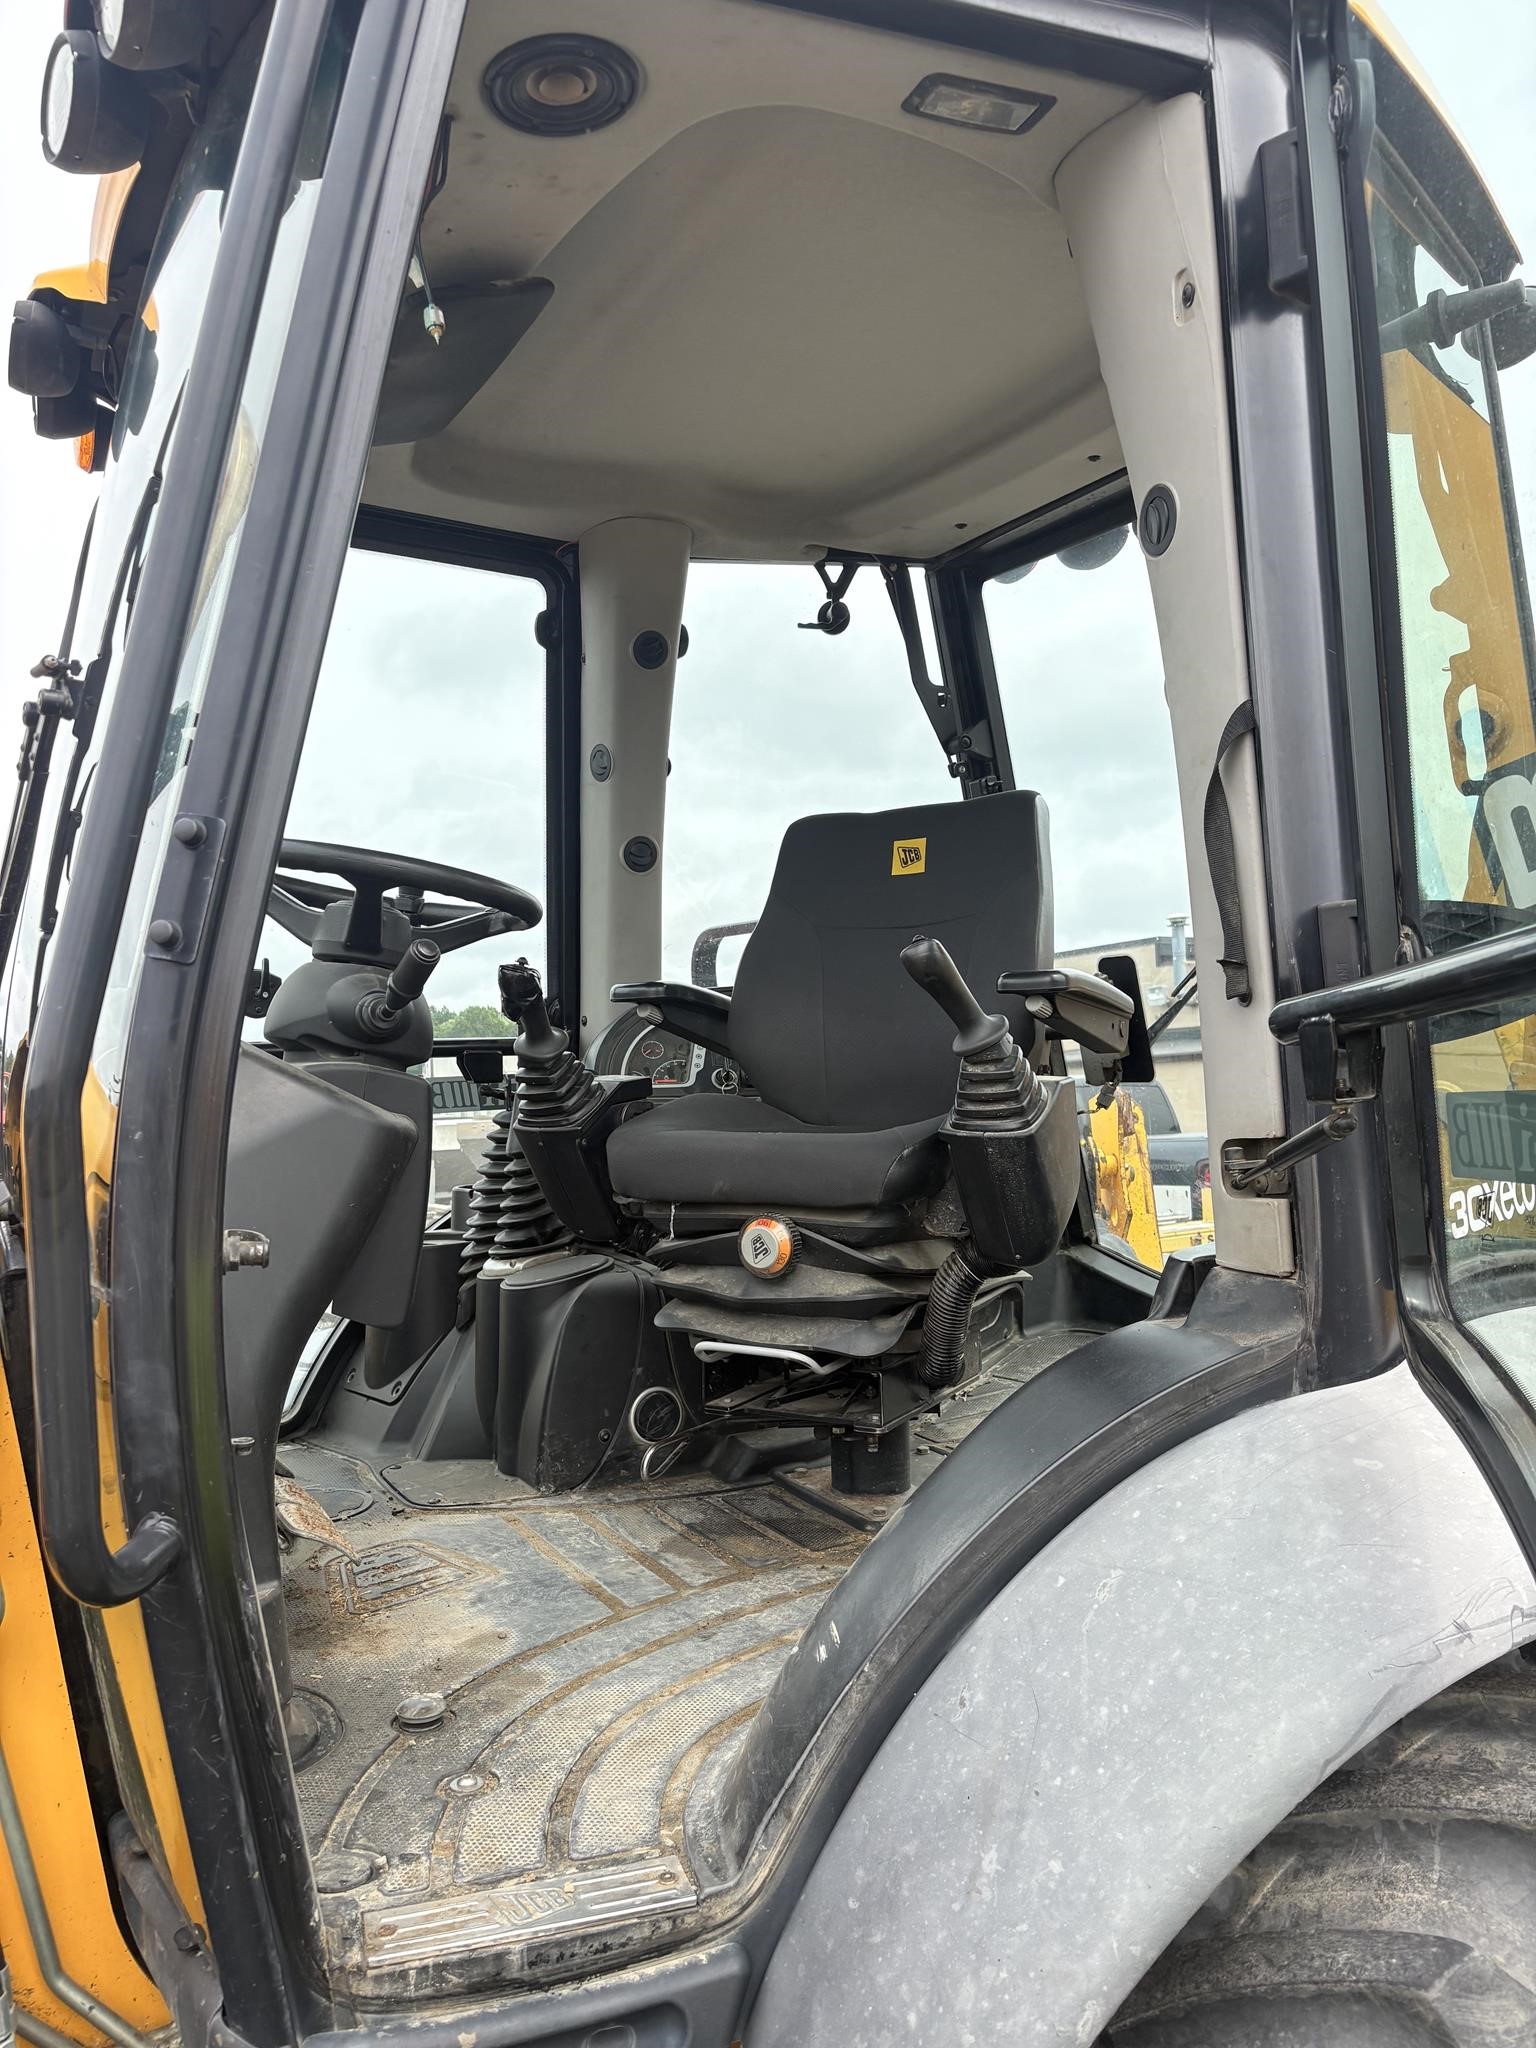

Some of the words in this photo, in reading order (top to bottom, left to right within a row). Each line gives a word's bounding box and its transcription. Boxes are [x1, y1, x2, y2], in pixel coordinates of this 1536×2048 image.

[901, 848, 920, 866] JCB
[752, 1236, 769, 1260] JCB
[503, 1888, 569, 1921] JCB
